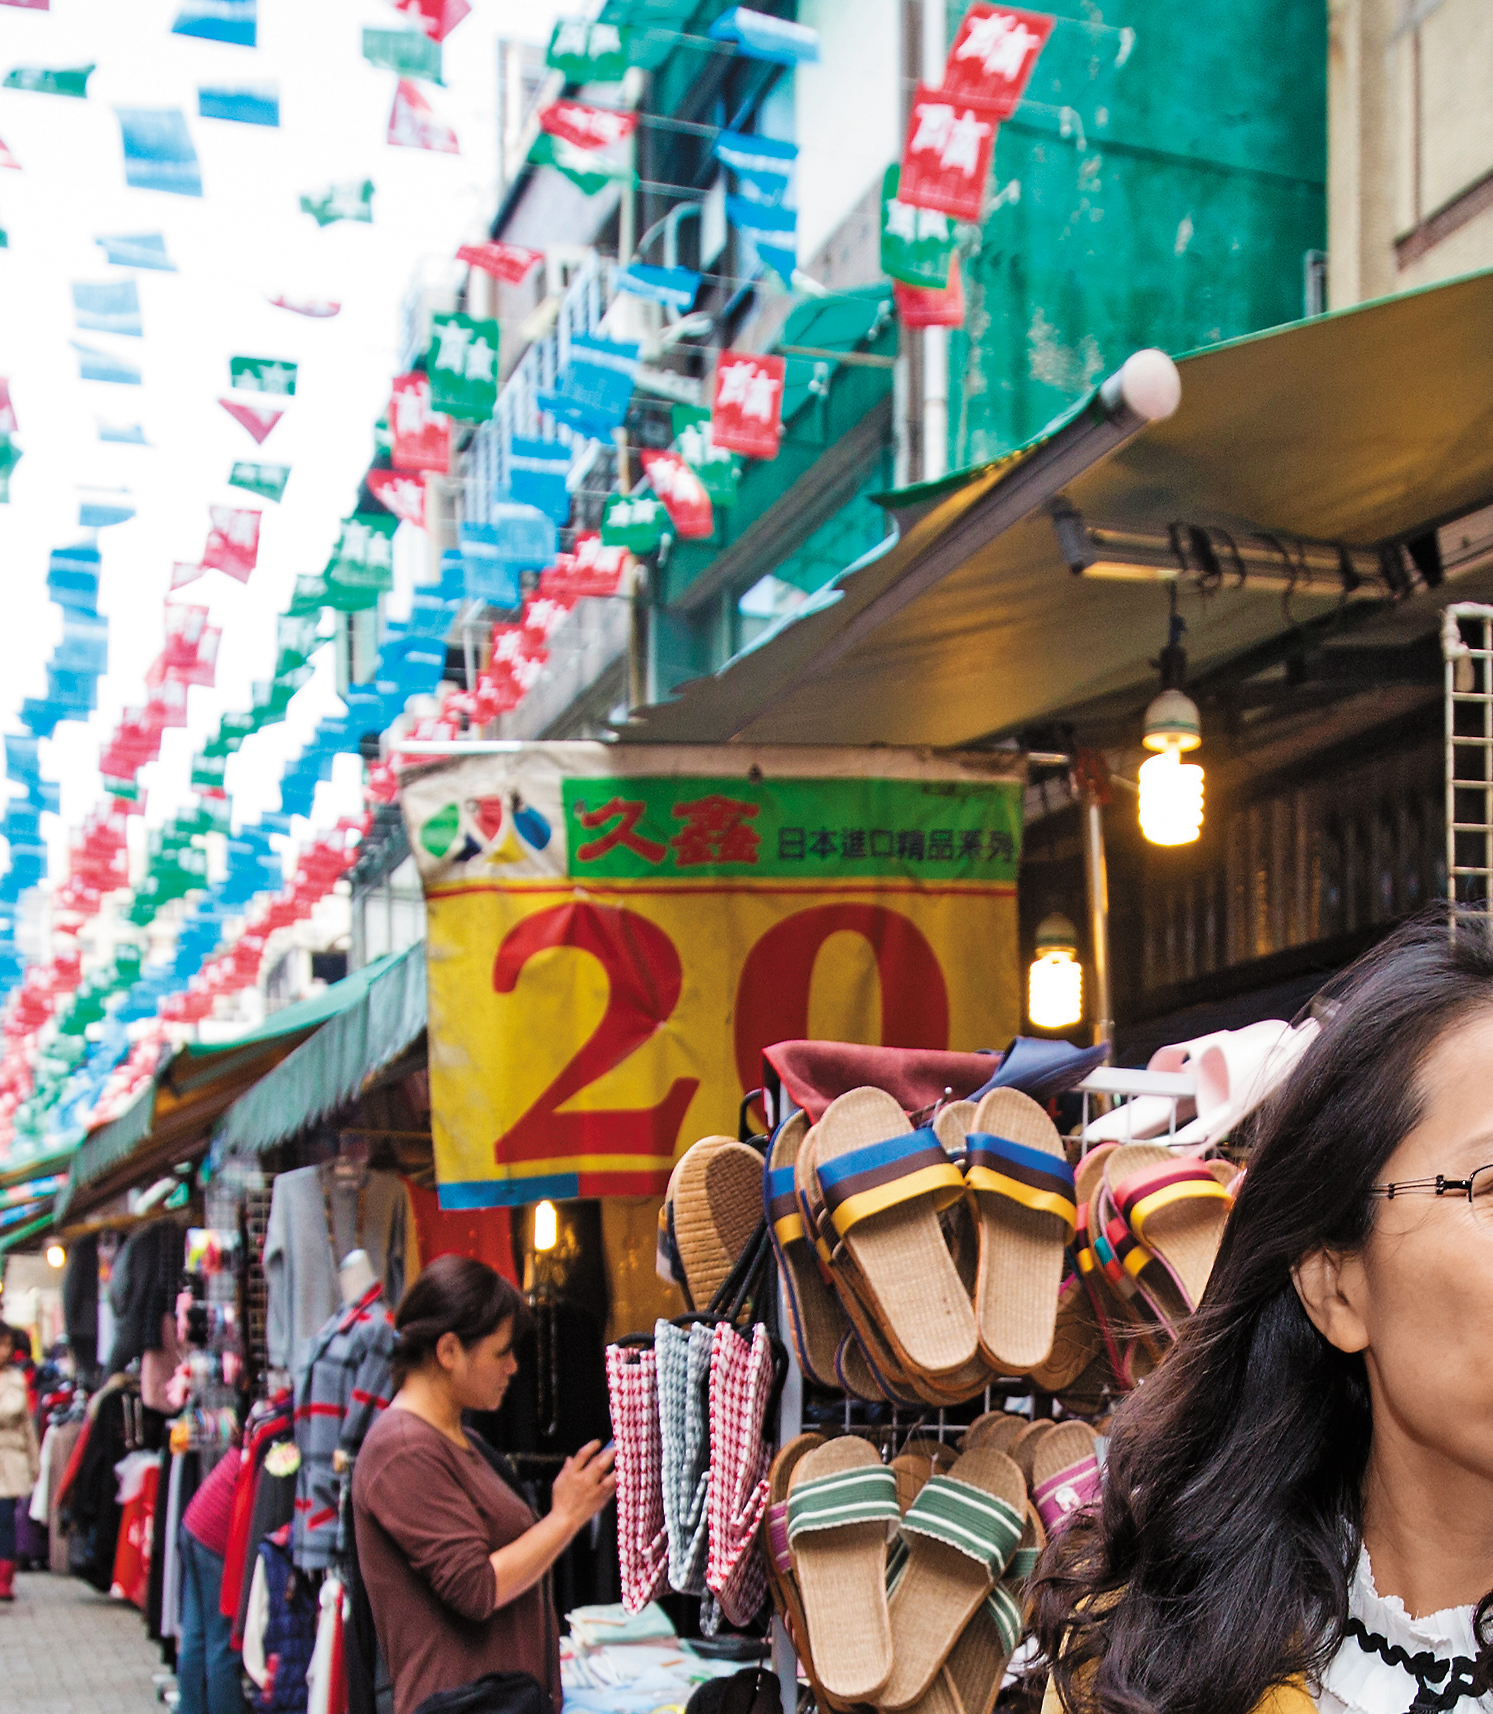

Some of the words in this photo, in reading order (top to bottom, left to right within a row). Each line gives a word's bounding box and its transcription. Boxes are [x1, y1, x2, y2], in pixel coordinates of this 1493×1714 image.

[576, 796, 762, 867] 久鑫
[777, 826, 1014, 863] 日本進口精品系列
[492, 901, 950, 1165] 20
